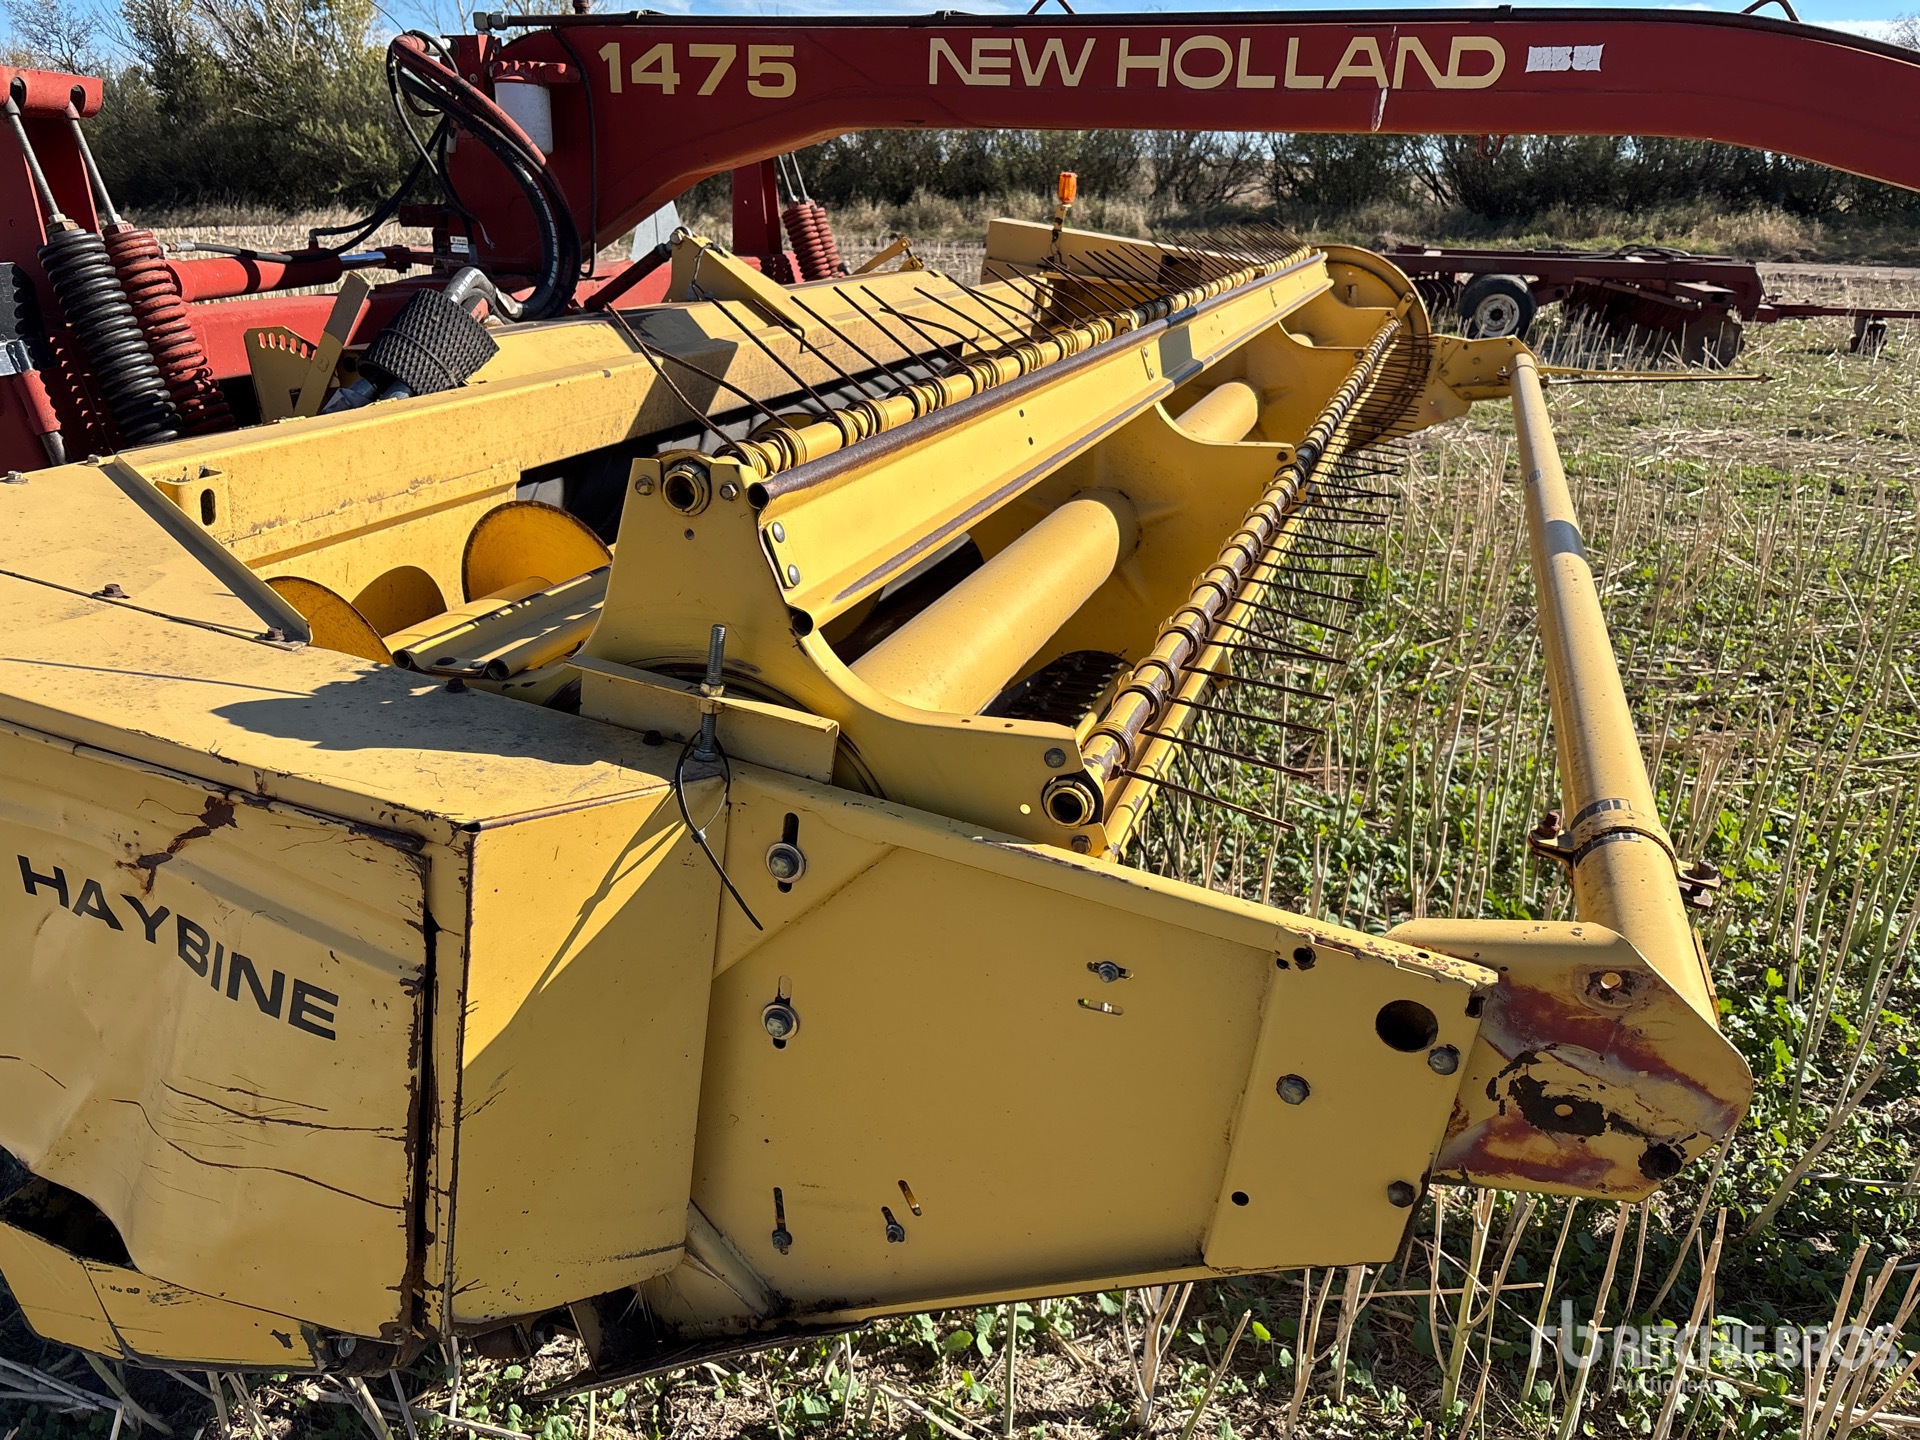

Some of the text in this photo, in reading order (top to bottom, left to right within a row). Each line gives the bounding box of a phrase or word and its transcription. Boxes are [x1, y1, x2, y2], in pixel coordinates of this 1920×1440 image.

[598, 42, 797, 98] 1475
[929, 34, 1506, 90] NEW HOLLAND
[17, 854, 339, 1041] HAYBINE
